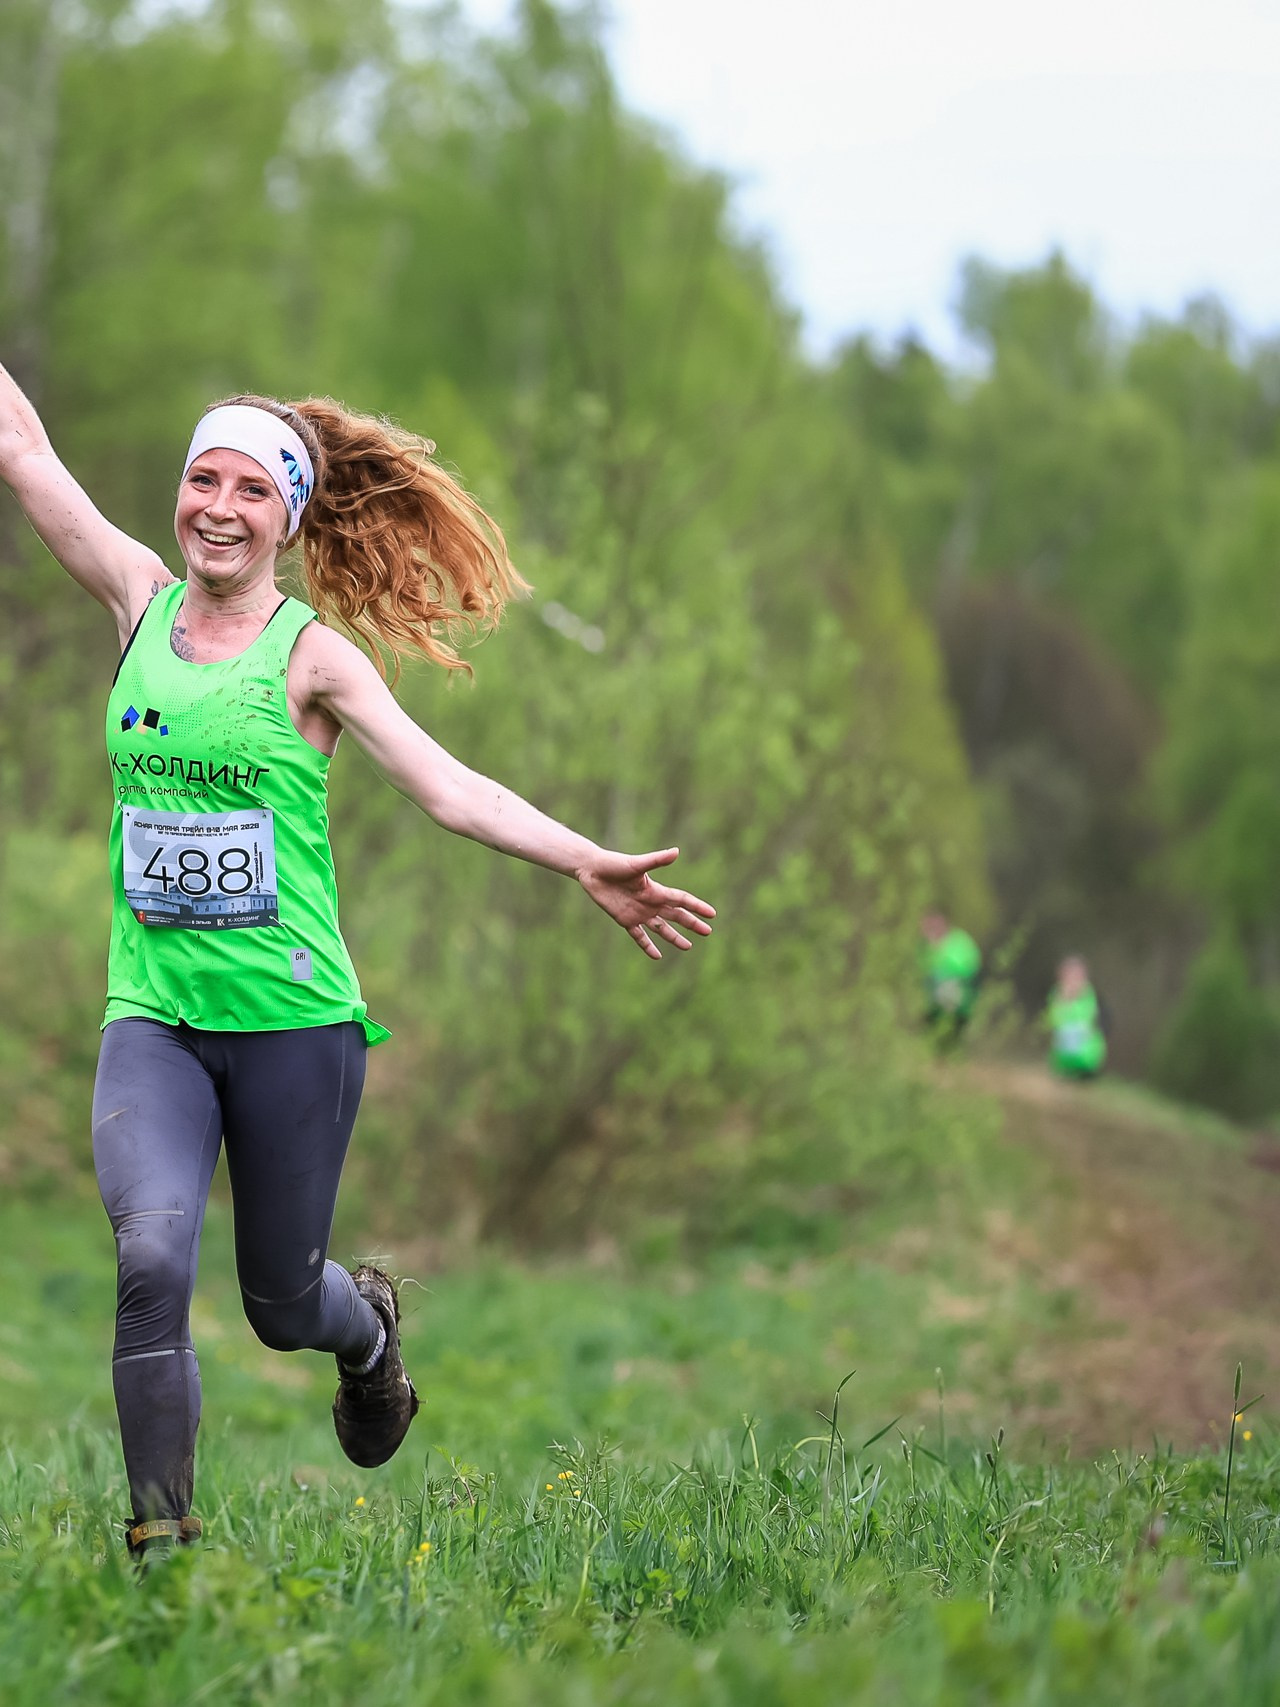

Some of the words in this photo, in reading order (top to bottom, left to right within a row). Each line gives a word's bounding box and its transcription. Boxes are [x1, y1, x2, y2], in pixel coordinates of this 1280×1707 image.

[110, 752, 270, 788] К-ХОЛДИНГ
[150, 785, 209, 798] компаний
[181, 825, 204, 833] ТРЕЙЛ
[142, 846, 254, 896] 488
